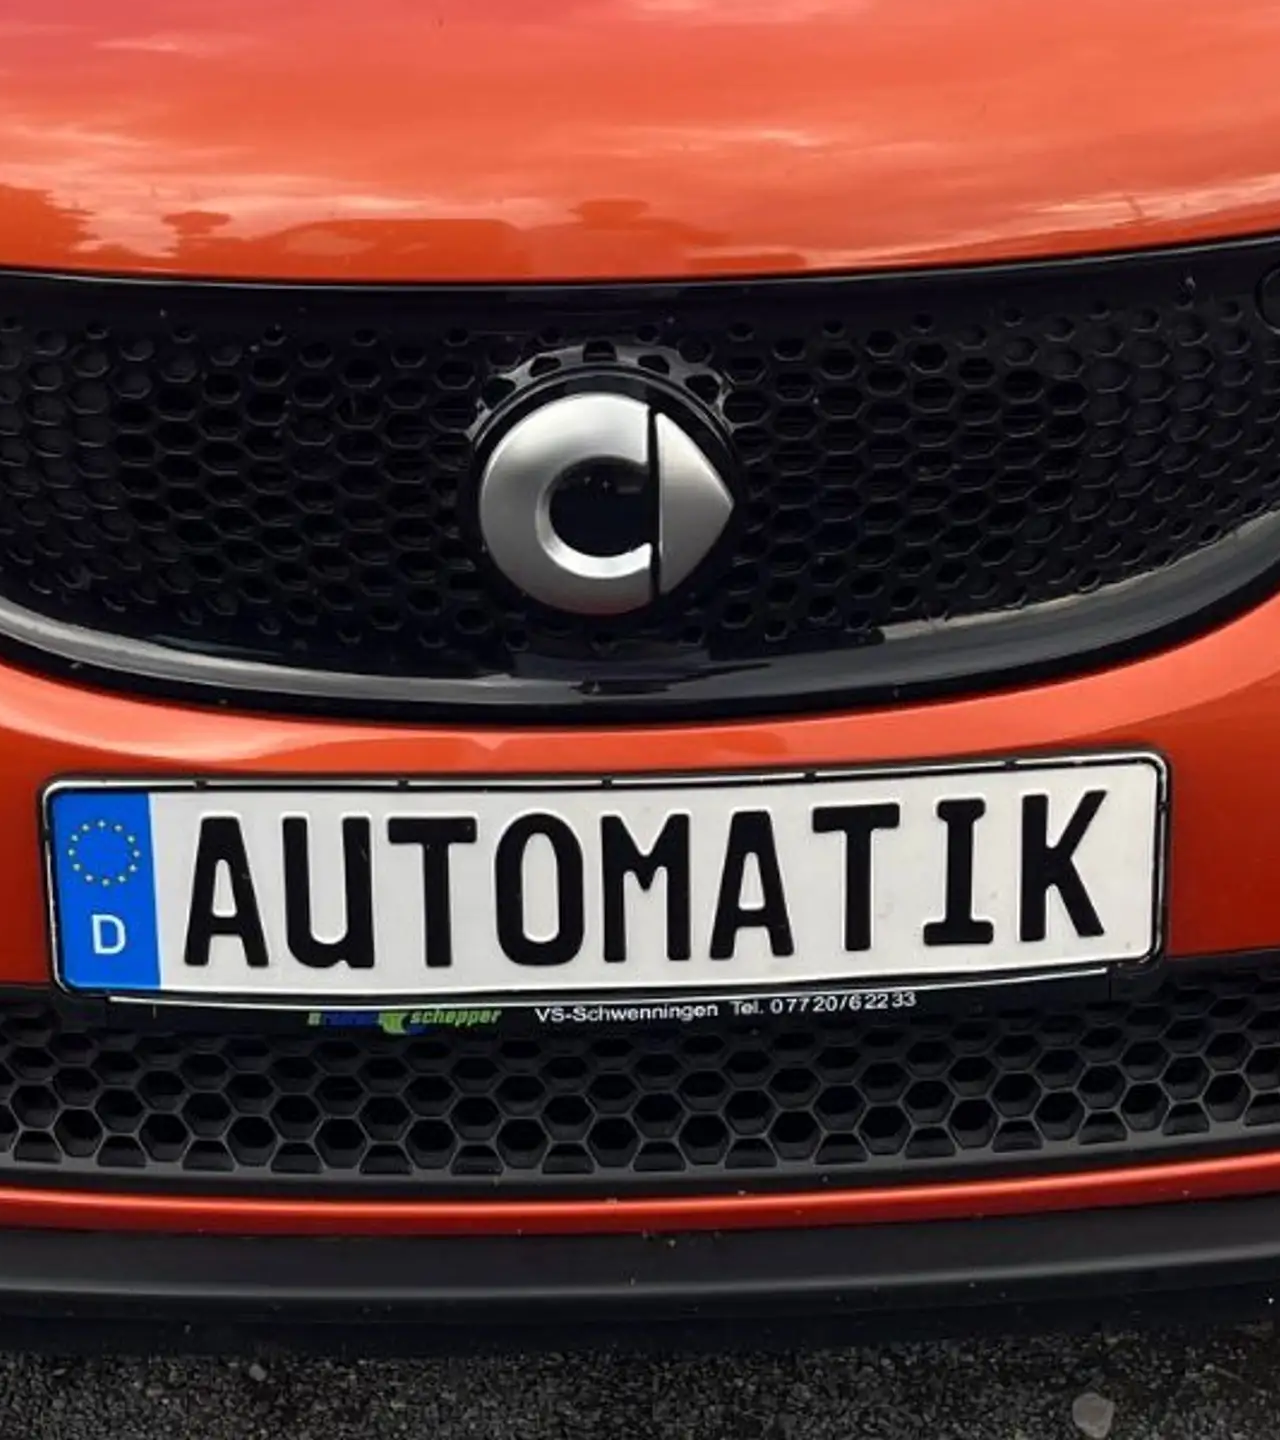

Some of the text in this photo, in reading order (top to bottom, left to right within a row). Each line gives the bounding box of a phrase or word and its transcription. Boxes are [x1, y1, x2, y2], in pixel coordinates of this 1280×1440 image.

[183, 789, 1108, 969] AUTOMATIK
[92, 914, 126, 954] D
[410, 1010, 502, 1027] schepper
[535, 1002, 719, 1024] VS-Schwenningen
[732, 999, 764, 1016] Tel.
